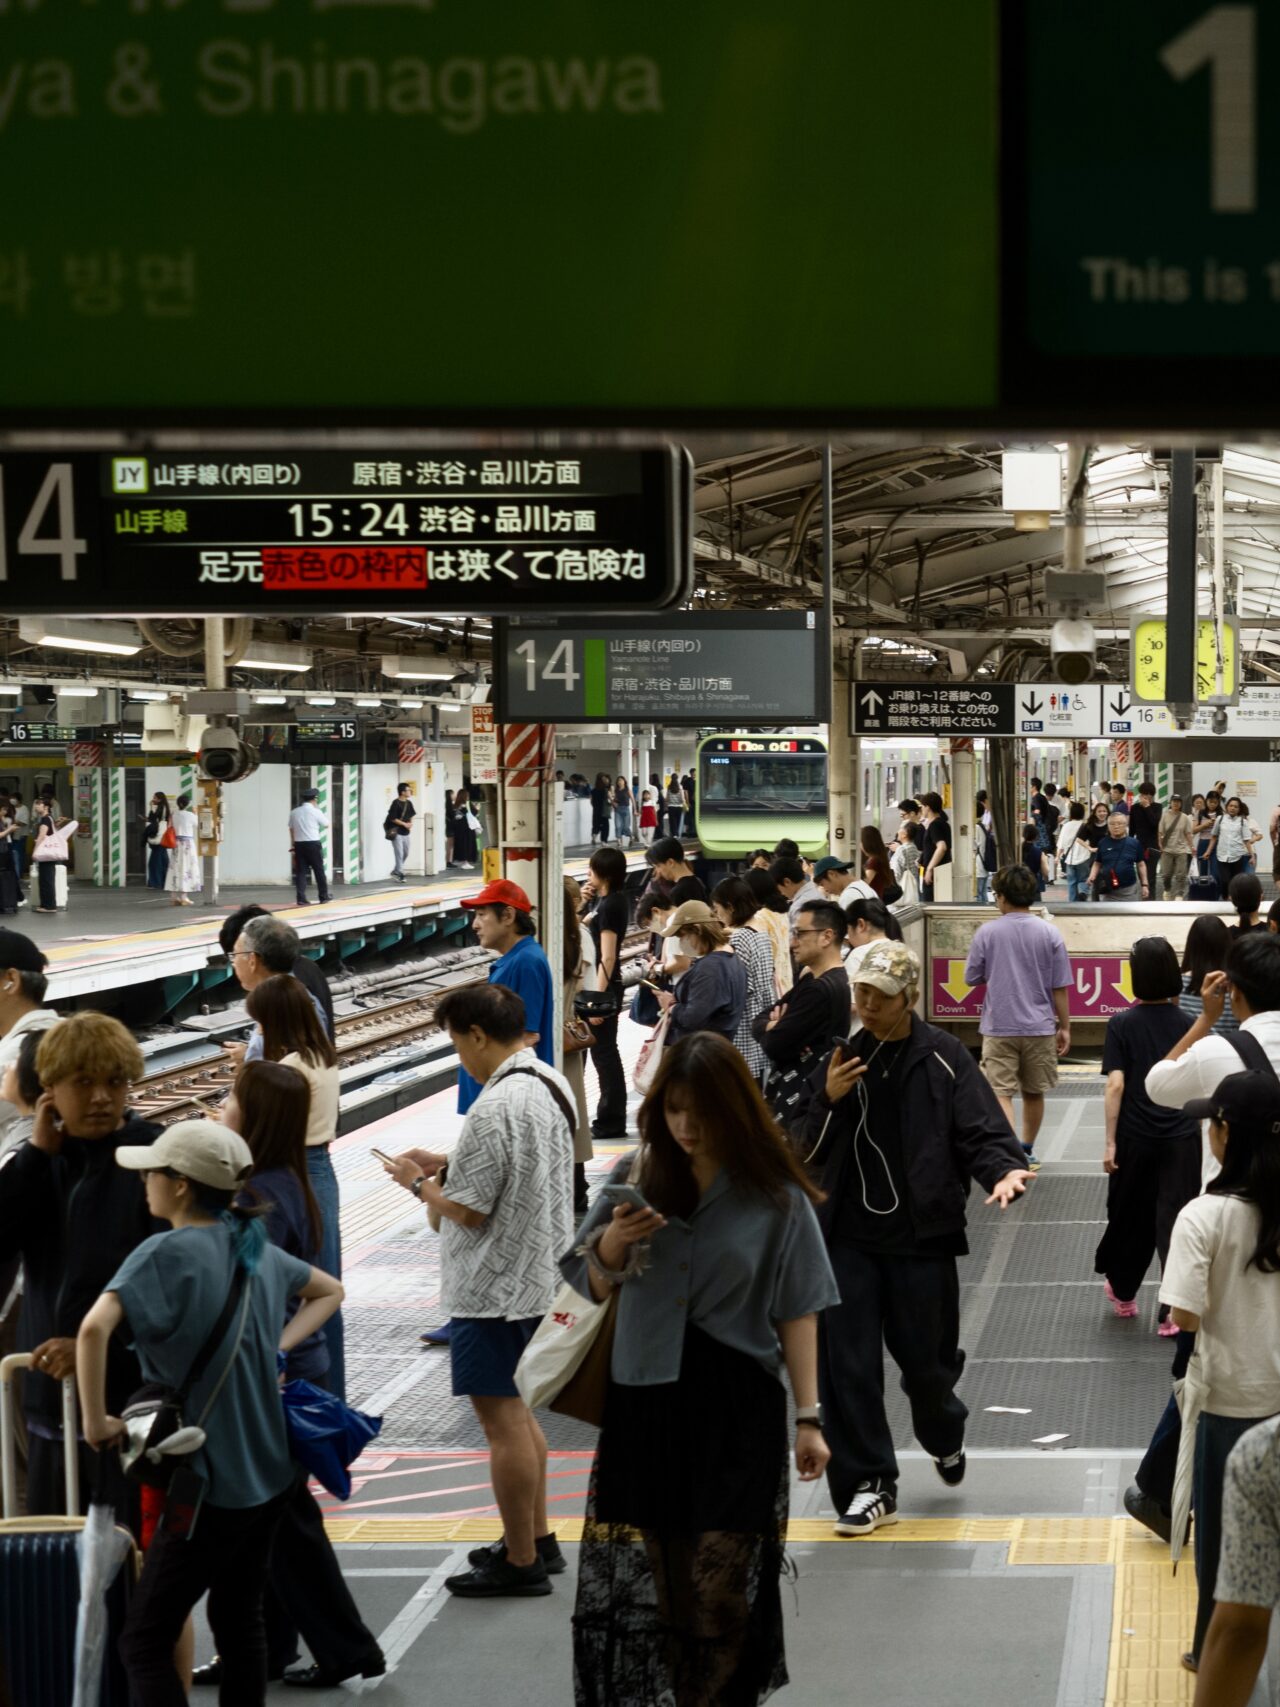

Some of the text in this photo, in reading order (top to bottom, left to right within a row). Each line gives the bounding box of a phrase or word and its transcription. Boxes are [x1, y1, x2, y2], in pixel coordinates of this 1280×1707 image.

[107, 42, 163, 117] &
[197, 39, 664, 134] Shinagawa
[1156, 3, 1259, 214] 1
[1081, 256, 1192, 304] This
[1203, 256, 1247, 304] is
[119, 465, 142, 485] JY
[153, 463, 301, 487] 山手線（内回り）
[352, 460, 581, 486] 原宿・渋谷・品川方面
[115, 510, 188, 534] 山手線
[287, 503, 410, 537] 15:24
[419, 505, 596, 534] 渋谷・品川方面
[609, 639, 702, 654] 山手線（内回り）
[1151, 641, 1164, 650] 10
[515, 639, 581, 692] 14
[652, 655, 670, 663] Line
[1144, 655, 1153, 665] 9
[611, 677, 733, 692] 原宿・渋谷・品川方面
[888, 703, 999, 714] お乗り換えは、この先の
[1137, 708, 1154, 723] 16
[887, 716, 997, 728] 階段をご利用ください。
[11, 724, 26, 740] 16
[339, 723, 355, 738] 15
[835, 828, 845, 839] 9
[936, 1004, 967, 1013] Down
